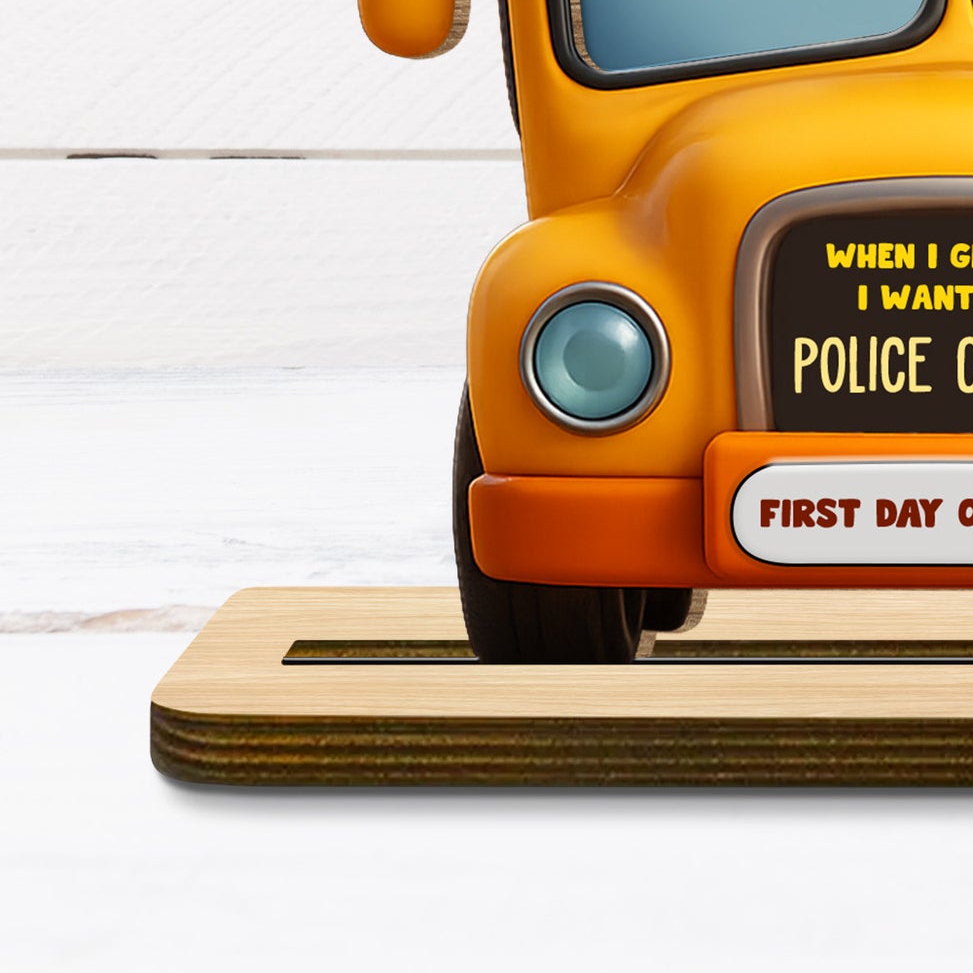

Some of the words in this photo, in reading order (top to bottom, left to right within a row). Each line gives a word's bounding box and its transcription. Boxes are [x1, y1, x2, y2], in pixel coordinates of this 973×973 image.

[825, 242, 915, 269] WHEN
[927, 243, 938, 269] I
[857, 284, 868, 311] I
[793, 335, 933, 394] POLICE
[759, 498, 861, 528] FIRST
[875, 498, 944, 528] DAY
